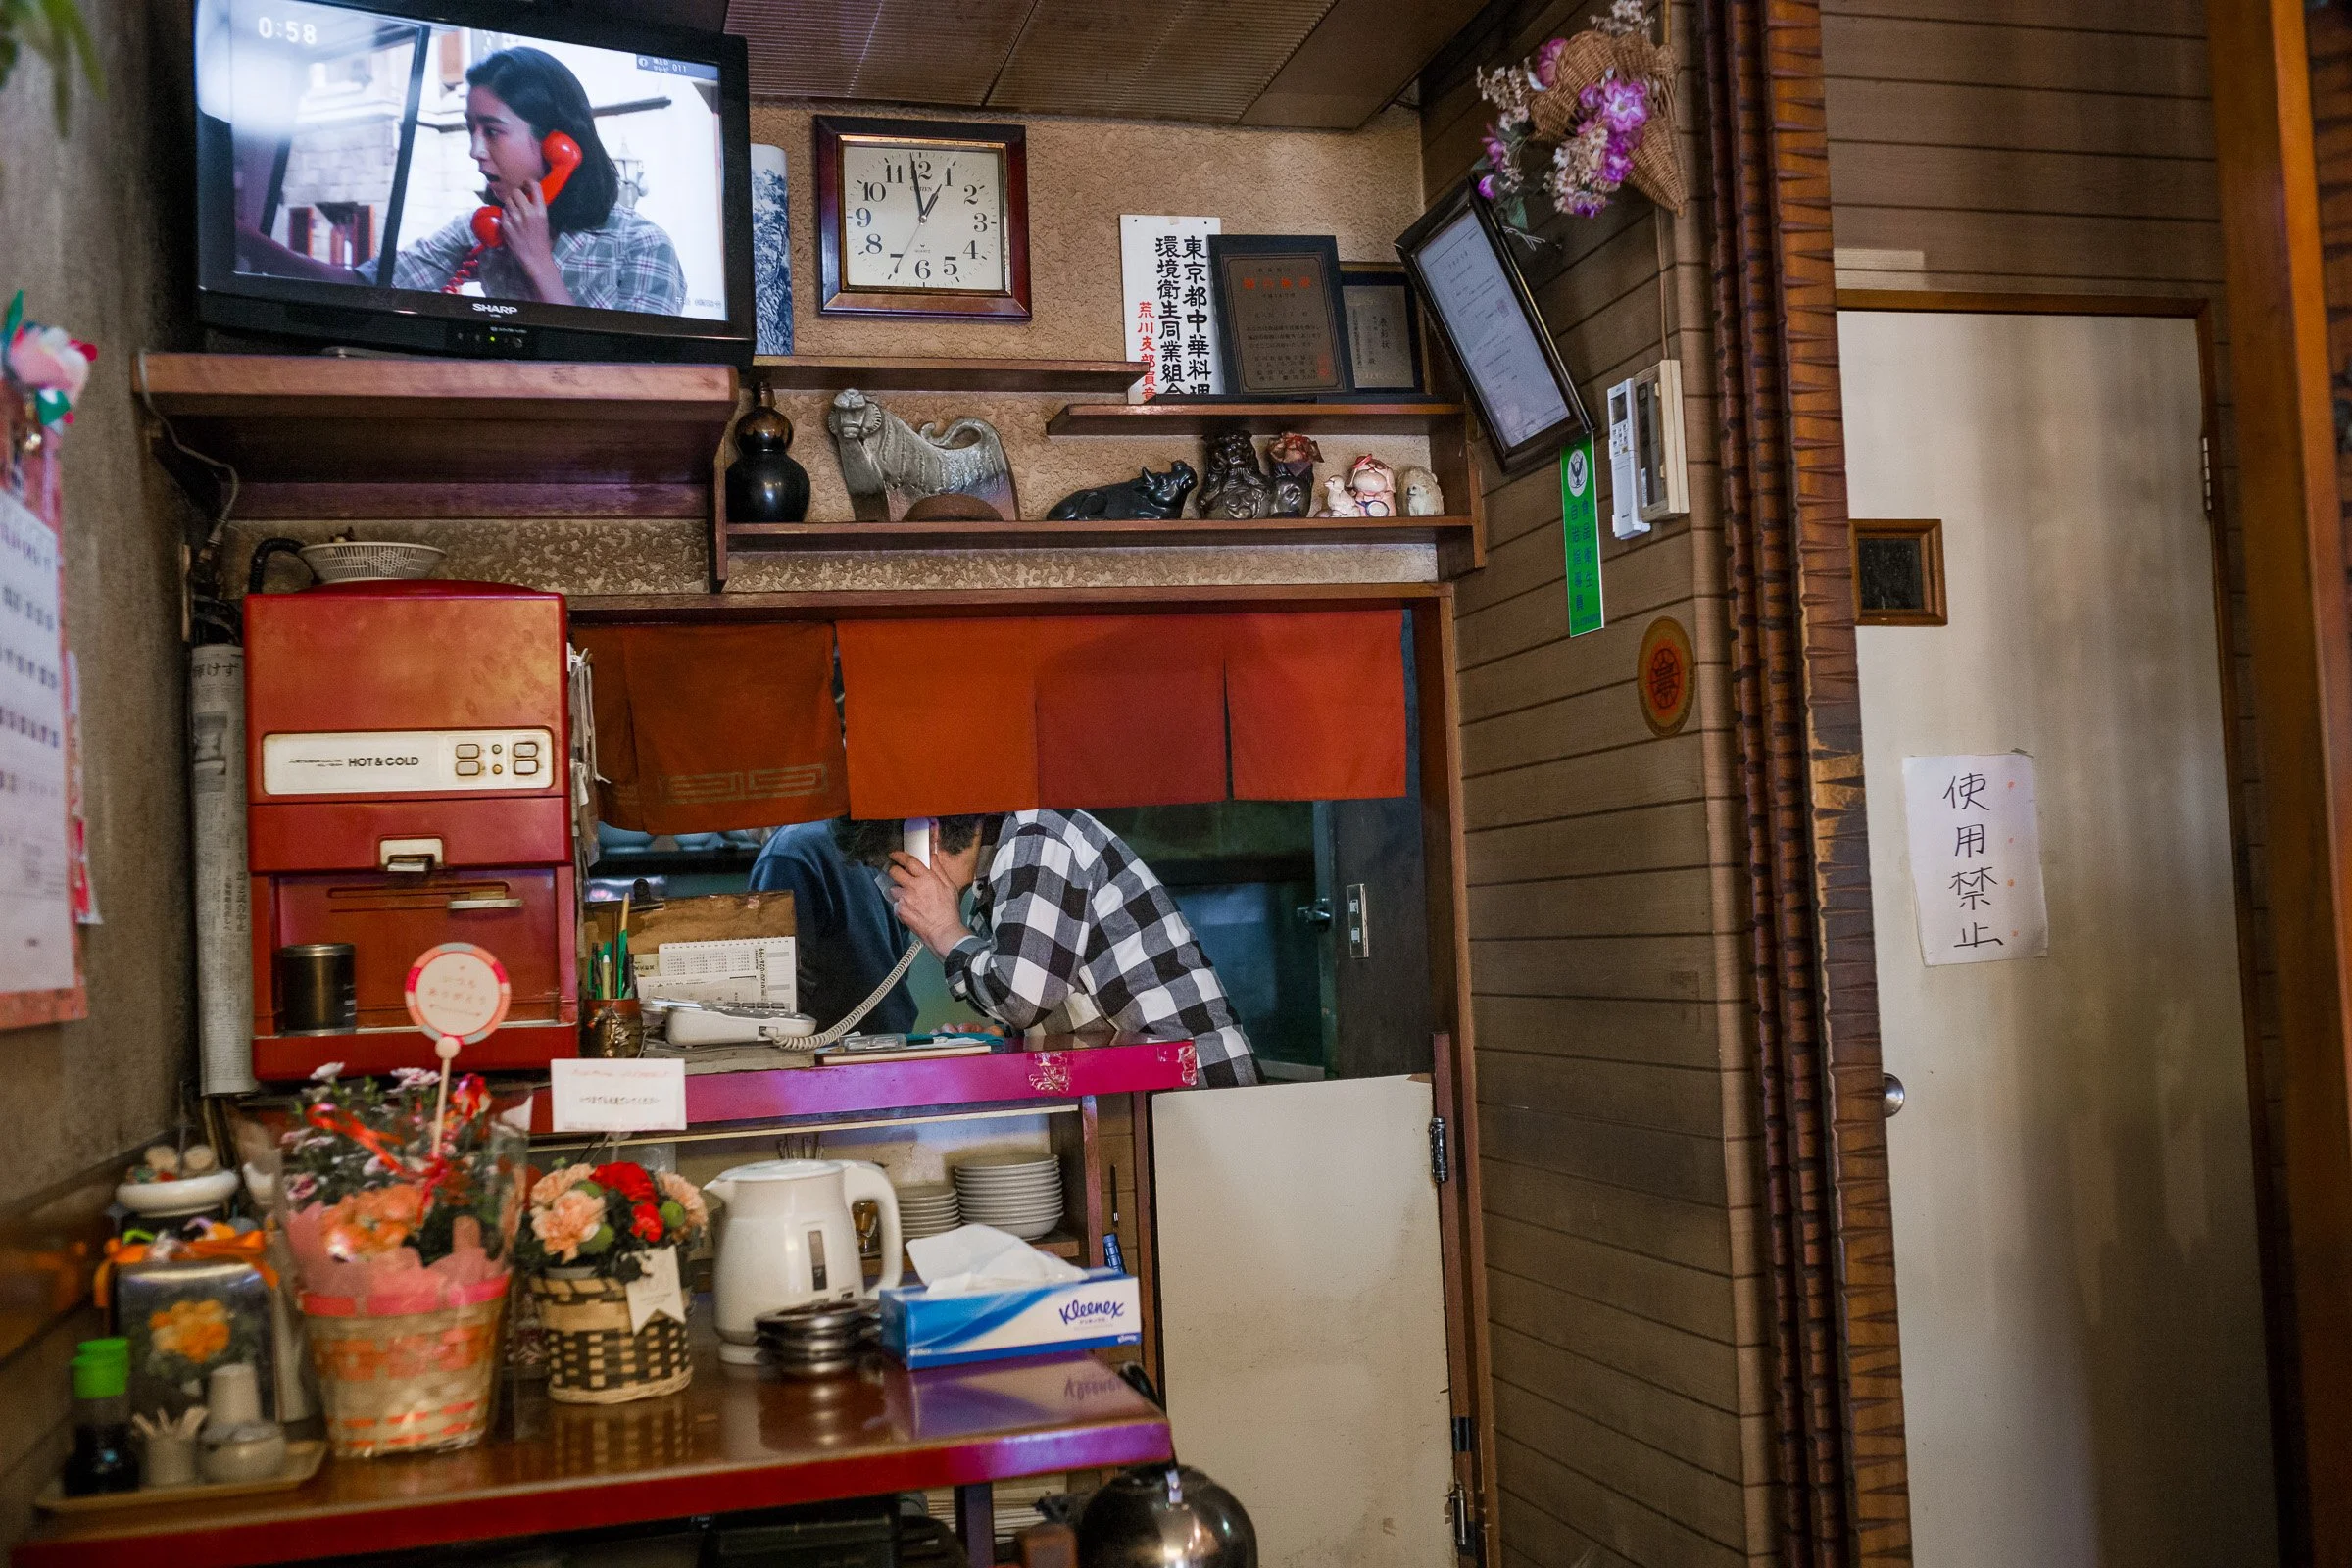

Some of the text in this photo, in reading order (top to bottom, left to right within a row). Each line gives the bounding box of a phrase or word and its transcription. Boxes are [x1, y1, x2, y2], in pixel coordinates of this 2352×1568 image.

[258, 16, 318, 45] 0:58
[672, 63, 686, 73] 011
[885, 164, 904, 183] 11
[945, 167, 954, 187] 1
[863, 181, 887, 202] 10
[963, 184, 979, 205] 2
[855, 207, 872, 227] 9
[973, 212, 988, 232] 3
[865, 233, 883, 254] 8
[963, 240, 979, 260] 4
[890, 254, 904, 274] 7
[914, 259, 931, 279] 6
[944, 256, 958, 276] 5
[471, 302, 518, 315] SHARP
[349, 757, 373, 767] HOT
[375, 758, 383, 766] &
[385, 757, 419, 766] COLD
[1942, 772, 2003, 948] 使用禁止
[1058, 1299, 1124, 1325] Kleenex
